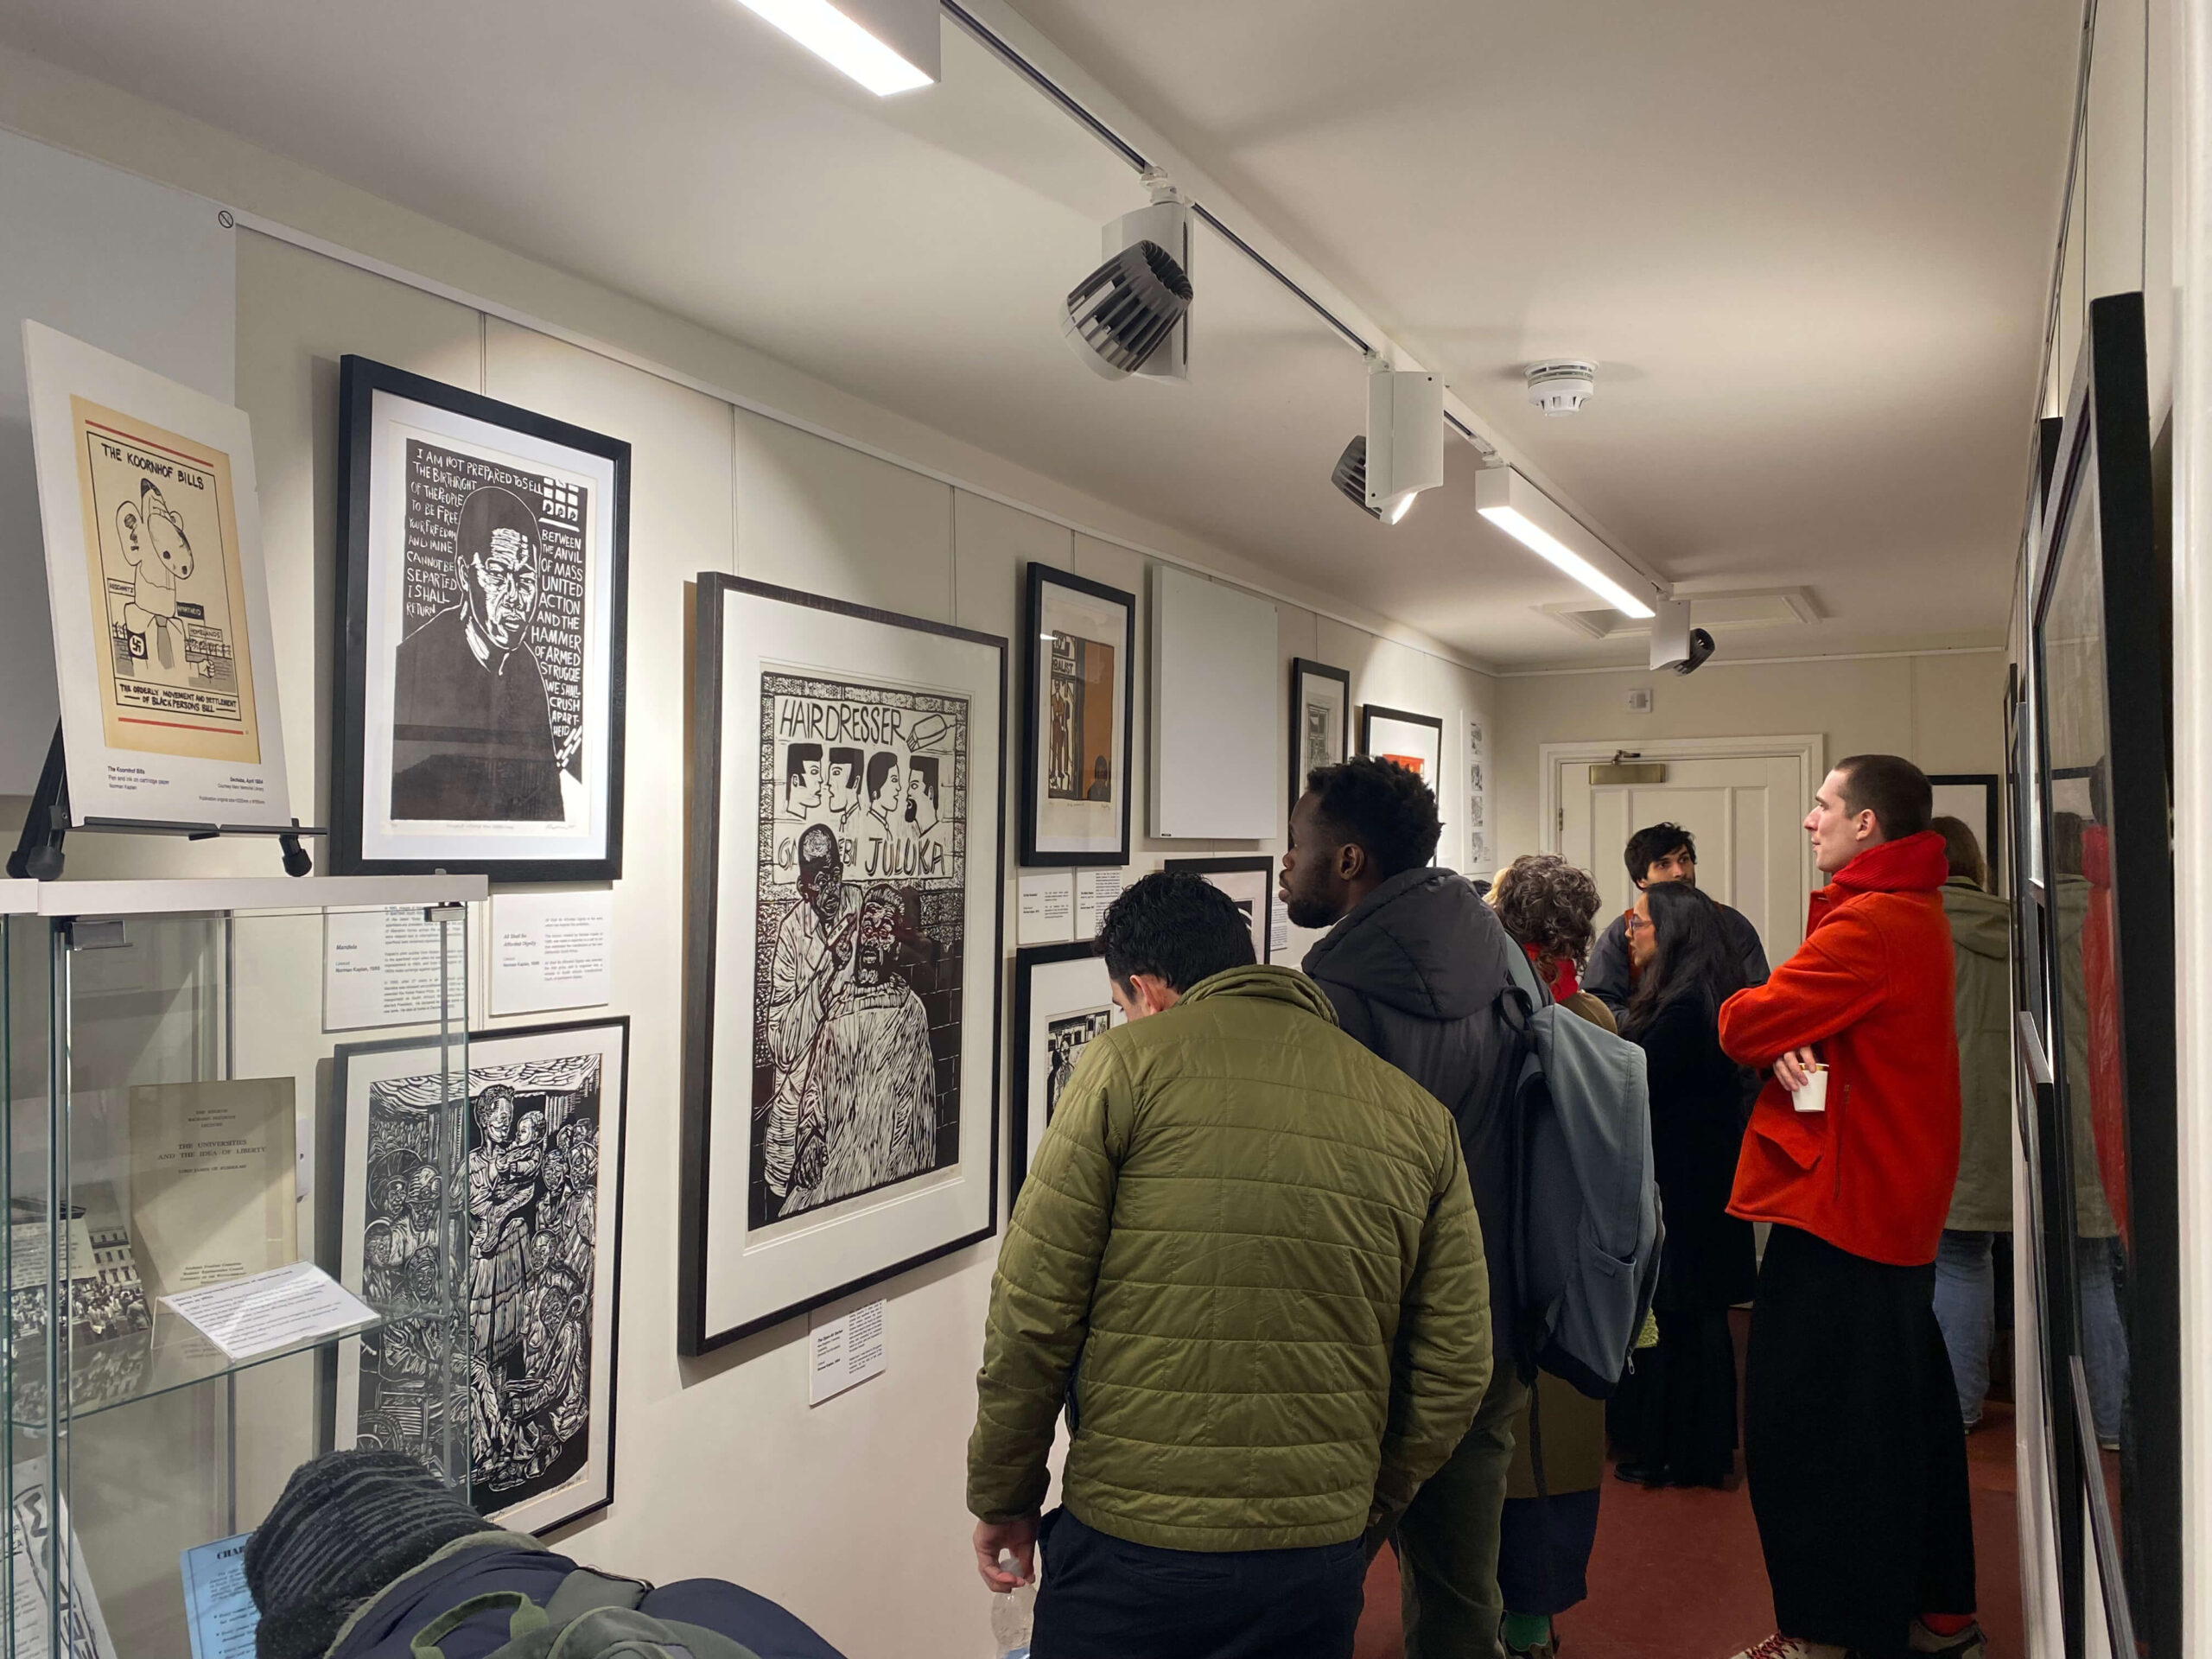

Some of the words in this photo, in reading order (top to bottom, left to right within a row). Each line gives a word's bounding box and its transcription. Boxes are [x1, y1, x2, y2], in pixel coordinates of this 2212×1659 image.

[101, 442, 122, 461] THE
[127, 453, 173, 478] KOORNHOF
[177, 470, 204, 490] BILLS
[412, 461, 431, 479] THE
[432, 467, 477, 491] BIRTHRIGHT
[416, 448, 423, 459] I
[426, 451, 442, 467] AM
[446, 455, 465, 472] NOT
[467, 461, 512, 485] PREPARED
[513, 474, 523, 486] TO
[522, 477, 543, 496] SELL
[410, 480, 422, 495] OF
[438, 486, 465, 507] PEOPLE
[411, 499, 422, 512] TO
[424, 503, 435, 516] BE
[437, 505, 459, 526] FREE
[408, 534, 428, 548] AND
[429, 540, 453, 554] MINE
[541, 529, 582, 550] BETWEEN
[406, 550, 442, 570] CANNOT
[443, 561, 454, 573] BE
[543, 543, 554, 555] THE
[554, 546, 583, 563] ANVIL
[541, 557, 553, 572] OF
[554, 562, 583, 582] MASS
[408, 584, 412, 599] I
[414, 584, 450, 604] SHALL
[542, 575, 583, 598] UNITED
[406, 601, 436, 618] RETURN
[538, 592, 581, 615] ACTION
[537, 610, 561, 626] AND
[561, 615, 581, 630] THE
[190, 628, 221, 639] HOMELANDS
[531, 625, 582, 654] HAMMER
[535, 645, 546, 659] OF
[545, 645, 582, 666] ARMED
[120, 683, 131, 693] THE
[132, 685, 159, 696] ORDERLY
[162, 690, 194, 702] MOVEMENT
[206, 696, 237, 708] SETTLEMENT
[545, 678, 561, 695] WE
[151, 696, 172, 707] BLACK
[172, 700, 200, 712] PERSONS
[201, 704, 215, 713] BILL
[549, 696, 581, 712] CRUSH
[553, 725, 570, 737] HEID
[779, 698, 908, 746] HAIRDRESSER
[864, 836, 946, 877] JULUKA
[198, 1140, 247, 1148] UNIVERSITIES
